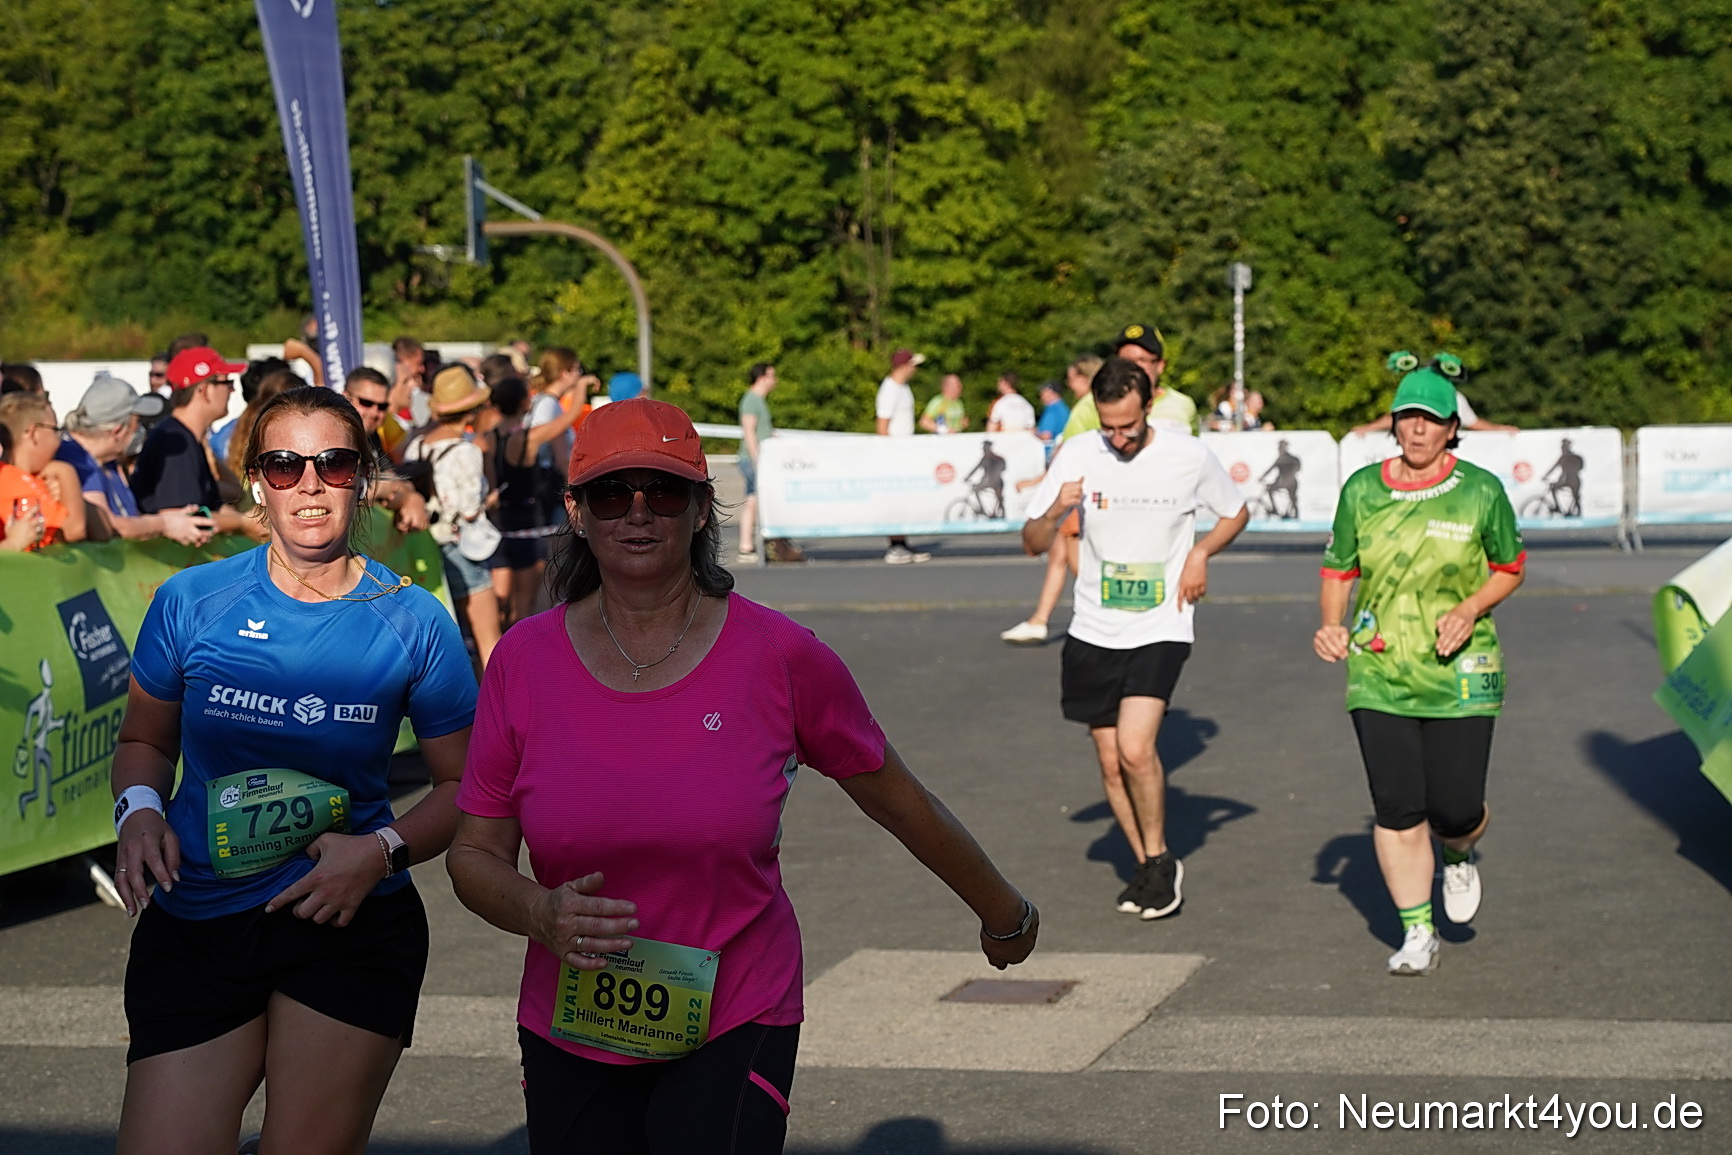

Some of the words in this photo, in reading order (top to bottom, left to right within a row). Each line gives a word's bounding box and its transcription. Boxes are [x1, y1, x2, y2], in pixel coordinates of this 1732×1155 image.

[1115, 580, 1149, 596] 179
[238, 629, 269, 640] erima
[208, 684, 288, 716] SCHICK
[339, 706, 374, 721] BAU
[204, 707, 230, 720] einfach
[230, 712, 257, 724] schick
[258, 716, 285, 728] bauen
[241, 782, 284, 800] Firmenlauf
[257, 788, 284, 799] neumarkt
[241, 796, 314, 840] 729
[215, 821, 231, 859] RUN
[230, 840, 282, 857] Banning
[614, 963, 644, 974] neumarkt
[562, 967, 580, 1024] WALK
[593, 972, 670, 1022] 899
[576, 1008, 615, 1029] Hillert
[617, 1018, 684, 1043] Marianne
[685, 997, 703, 1047] 2022
[601, 1032, 627, 1044] Lebenshilfe
[626, 1039, 652, 1048] Neumarkt
